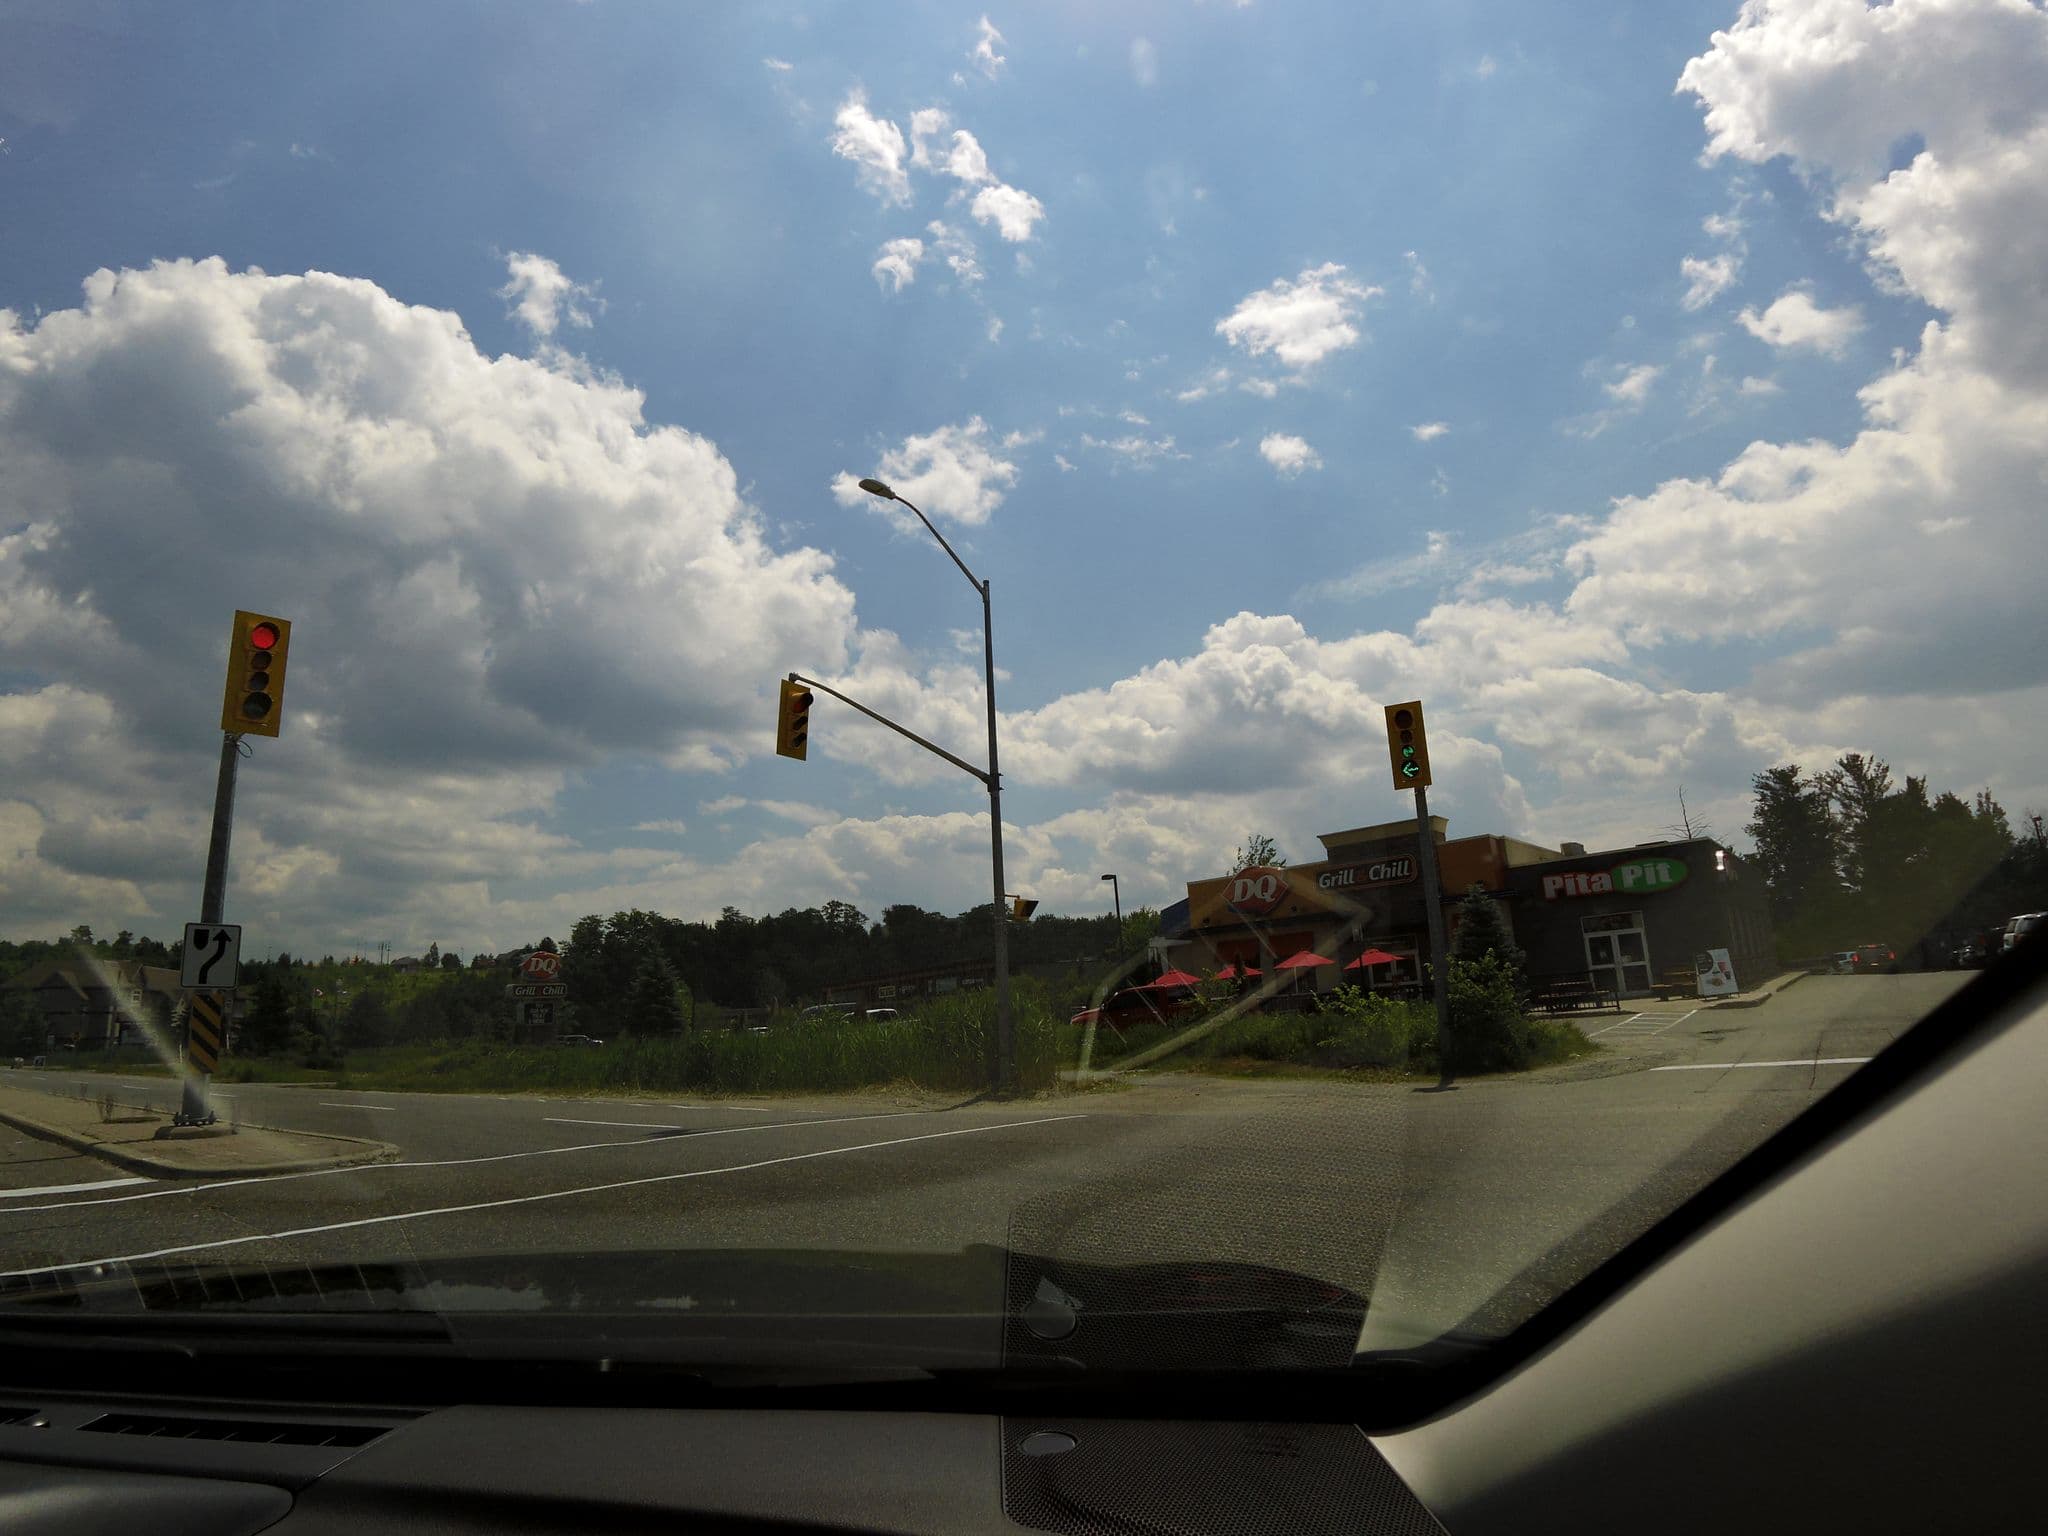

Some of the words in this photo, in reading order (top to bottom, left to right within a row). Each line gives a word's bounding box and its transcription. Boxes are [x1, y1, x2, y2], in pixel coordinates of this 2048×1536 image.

[1319, 869, 1355, 888] Grill
[1368, 860, 1411, 881] Chill
[1543, 871, 1612, 899] Pita
[1621, 862, 1673, 889] Pit
[1232, 875, 1276, 902] DQ
[528, 958, 556, 974] DQ
[515, 986, 536, 995] Grill
[543, 985, 564, 995] Chill
